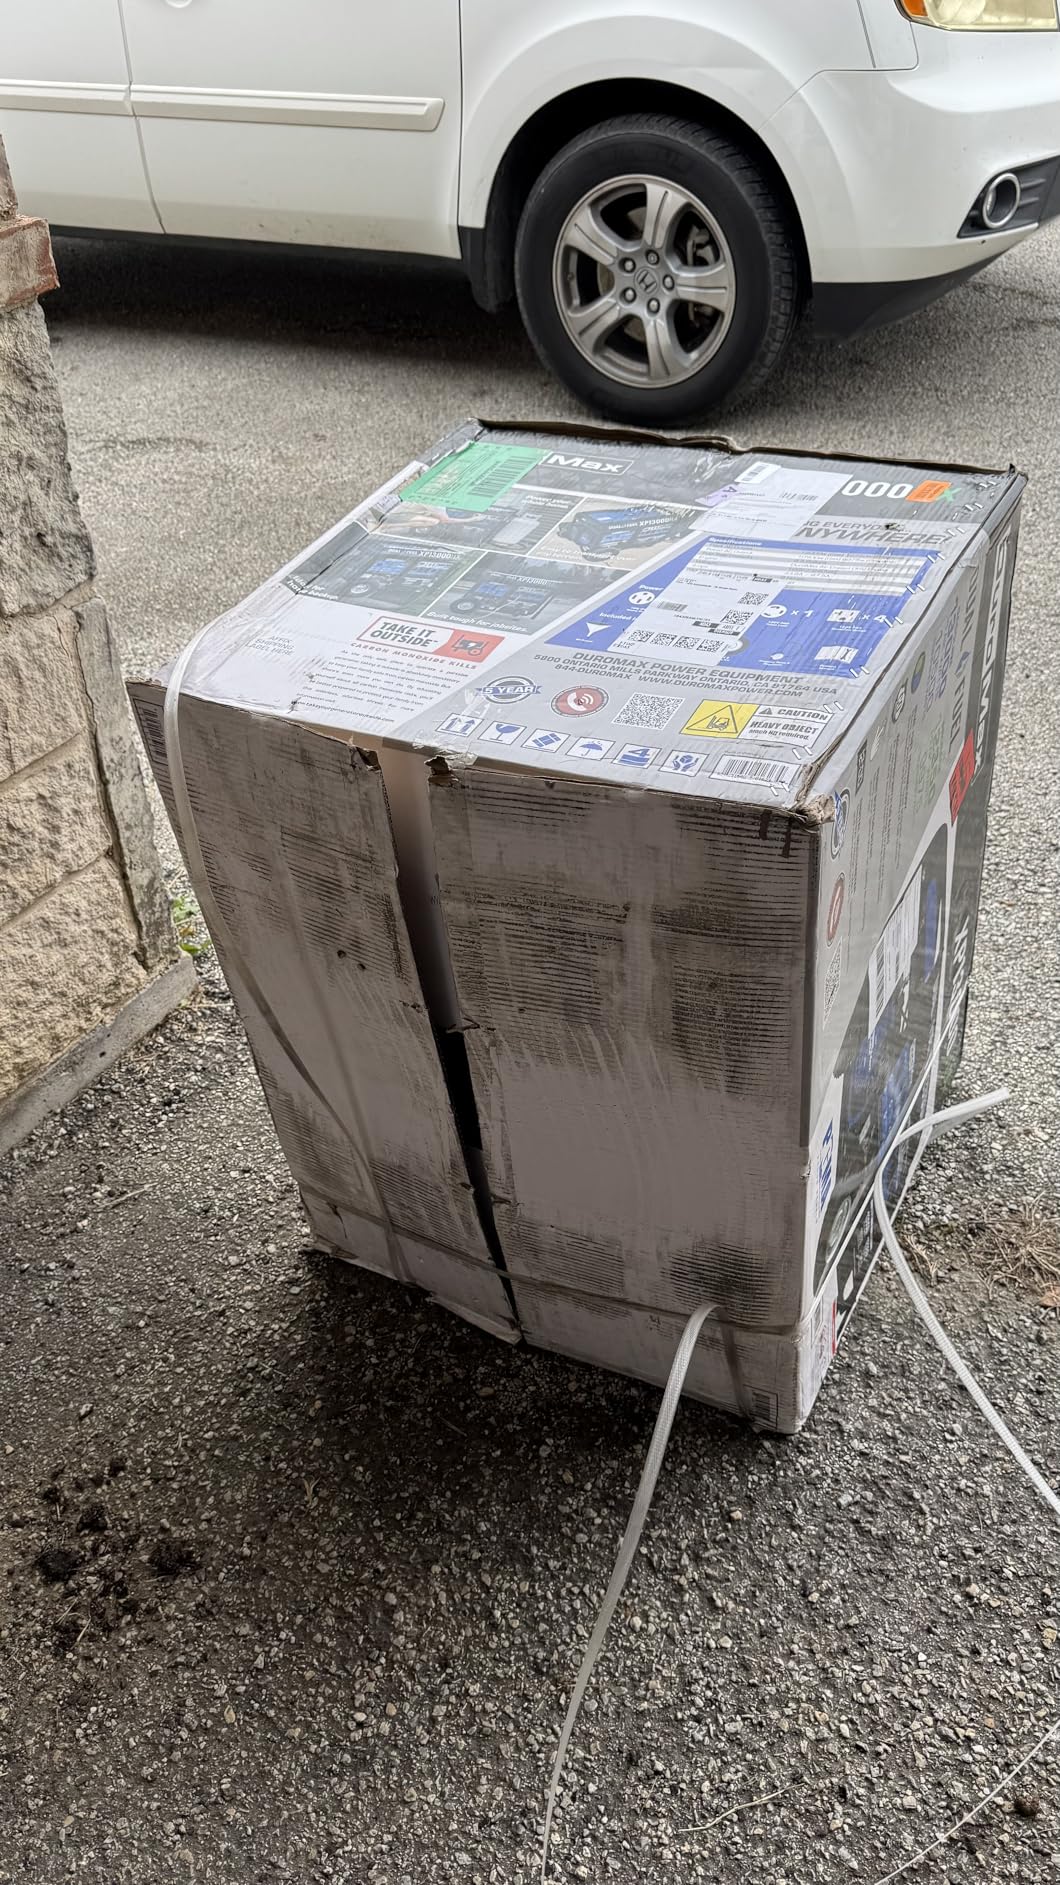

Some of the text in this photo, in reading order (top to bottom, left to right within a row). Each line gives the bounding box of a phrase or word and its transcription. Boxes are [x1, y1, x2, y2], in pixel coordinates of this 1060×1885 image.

[547, 454, 624, 473] Max
[380, 622, 436, 638] TAKE IT
[348, 642, 478, 670] CARBON MONOXIDE KILLS
[532, 654, 562, 662] 5800
[560, 658, 609, 669] ONTARIO
[607, 664, 643, 674] MILLS
[641, 669, 698, 680] PARKWAY
[811, 686, 839, 695] USA
[571, 651, 804, 685] DUROMAX POWER EQUIPMENT
[497, 684, 533, 696] YEAR
[552, 663, 804, 697] 844-DUROMAX WWW.DUROMAXPOWER.COM
[778, 708, 828, 720] CAUTION
[950, 677, 965, 753] FUEL
[782, 723, 819, 734] OBJECT
